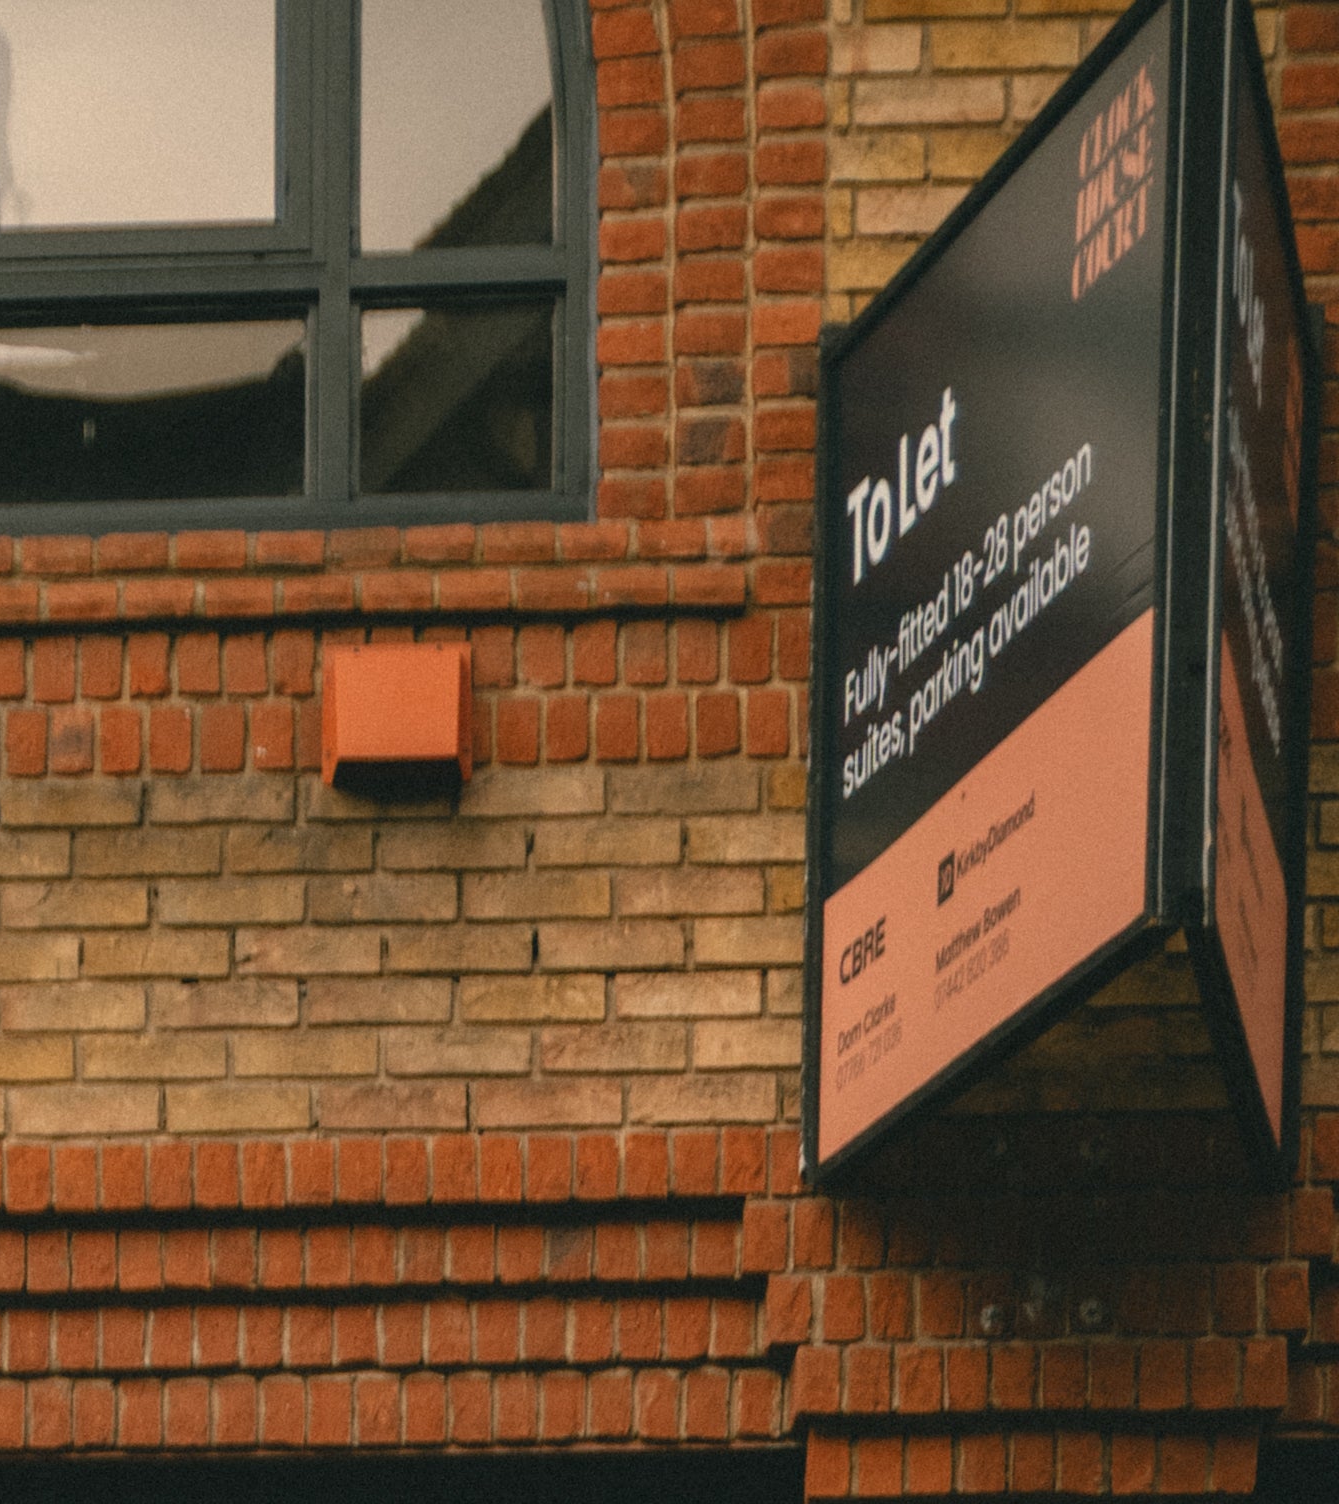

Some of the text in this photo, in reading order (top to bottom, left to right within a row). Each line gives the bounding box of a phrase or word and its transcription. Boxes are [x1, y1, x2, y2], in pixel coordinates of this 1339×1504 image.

[1071, 176, 1155, 300] COURT
[1074, 118, 1155, 244] HOUSE
[846, 387, 957, 584] To Let
[842, 524, 1091, 797] suites, parking available
[844, 441, 1093, 721] Fully-fitted 18-28 person
[839, 914, 887, 986] CBRE
